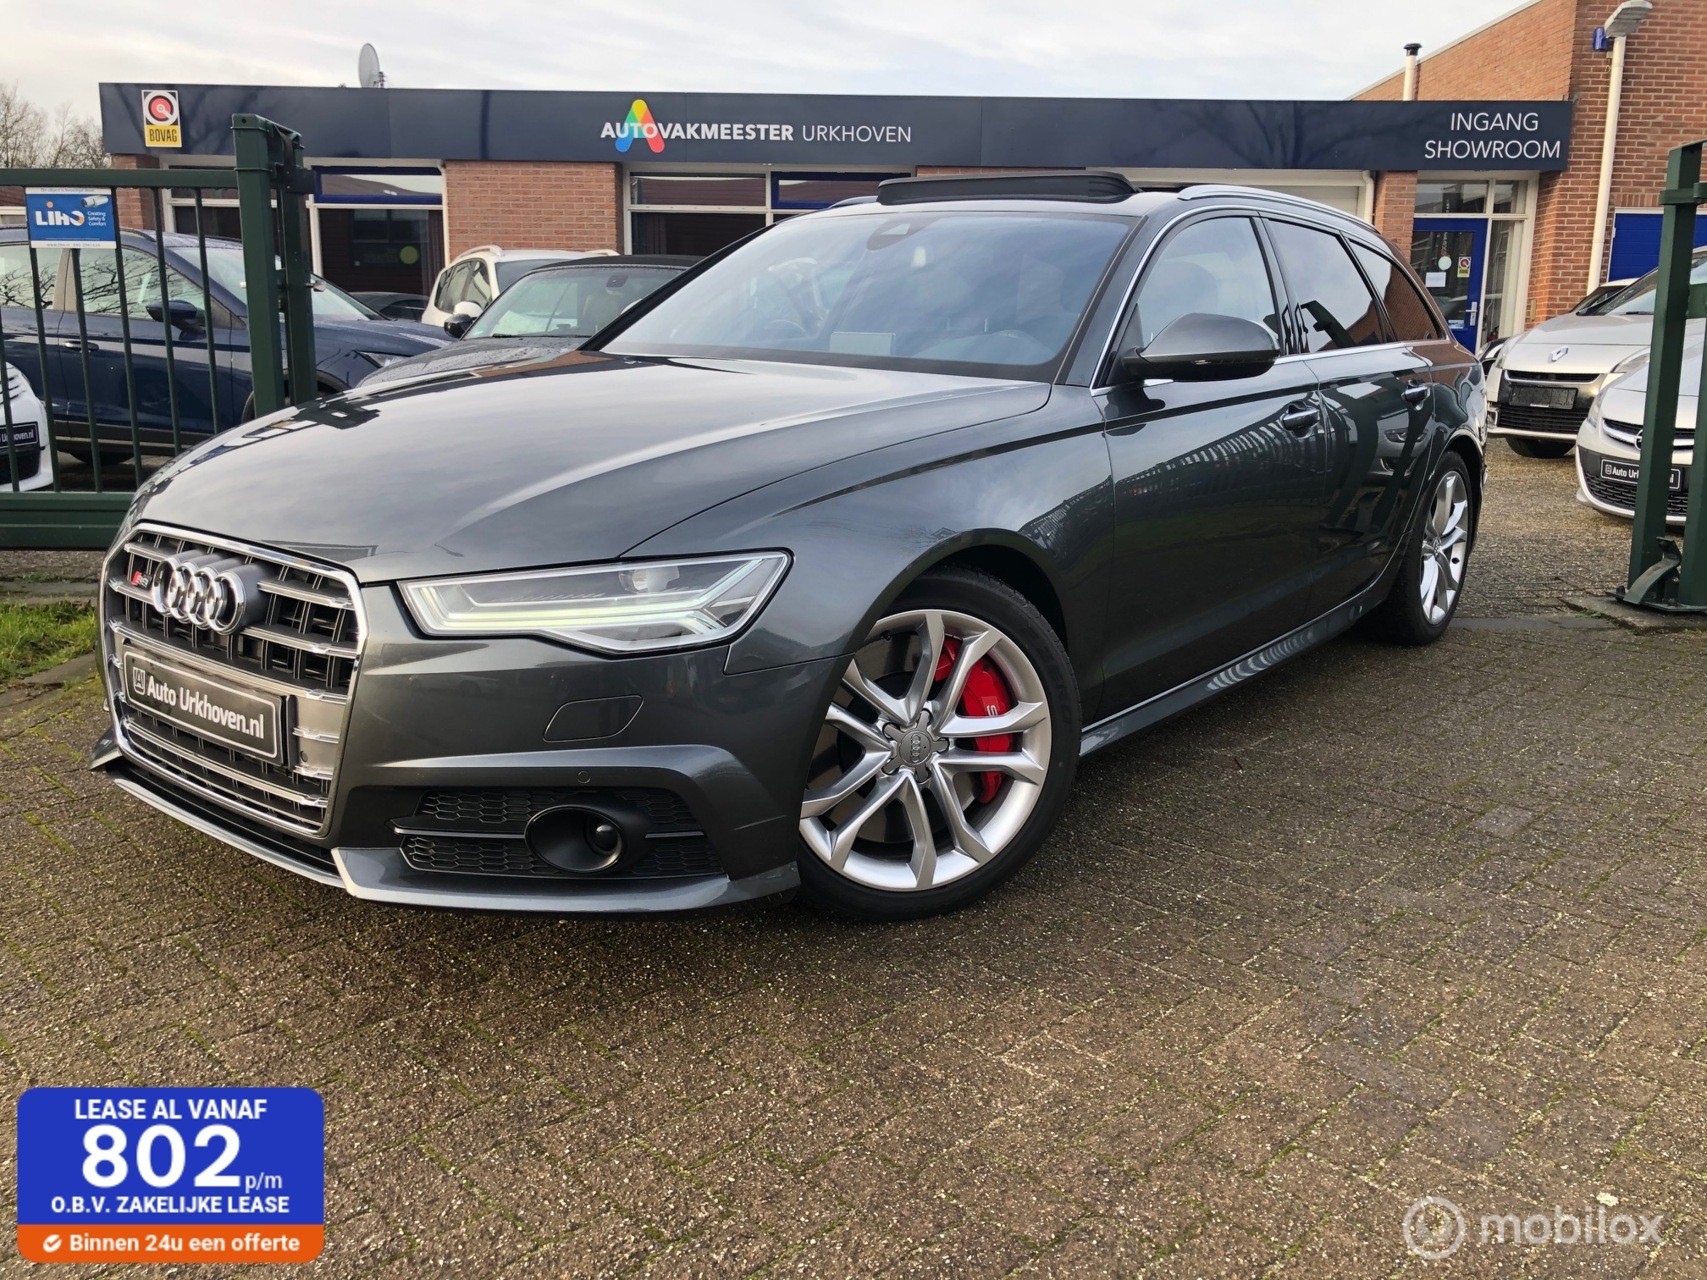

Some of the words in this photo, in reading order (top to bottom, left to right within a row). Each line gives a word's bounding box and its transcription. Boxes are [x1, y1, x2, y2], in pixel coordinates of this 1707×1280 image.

[1450, 112, 1539, 131] INGANG
[149, 128, 178, 142] BOVAG
[600, 122, 794, 141] AUTOVAKMEESTER
[802, 124, 912, 143] URKHOVEN
[1424, 140, 1561, 159] SHOWROOM
[1612, 466, 1627, 477] Auto
[147, 675, 177, 706] Auto
[179, 687, 265, 739] Urkhoven.nl
